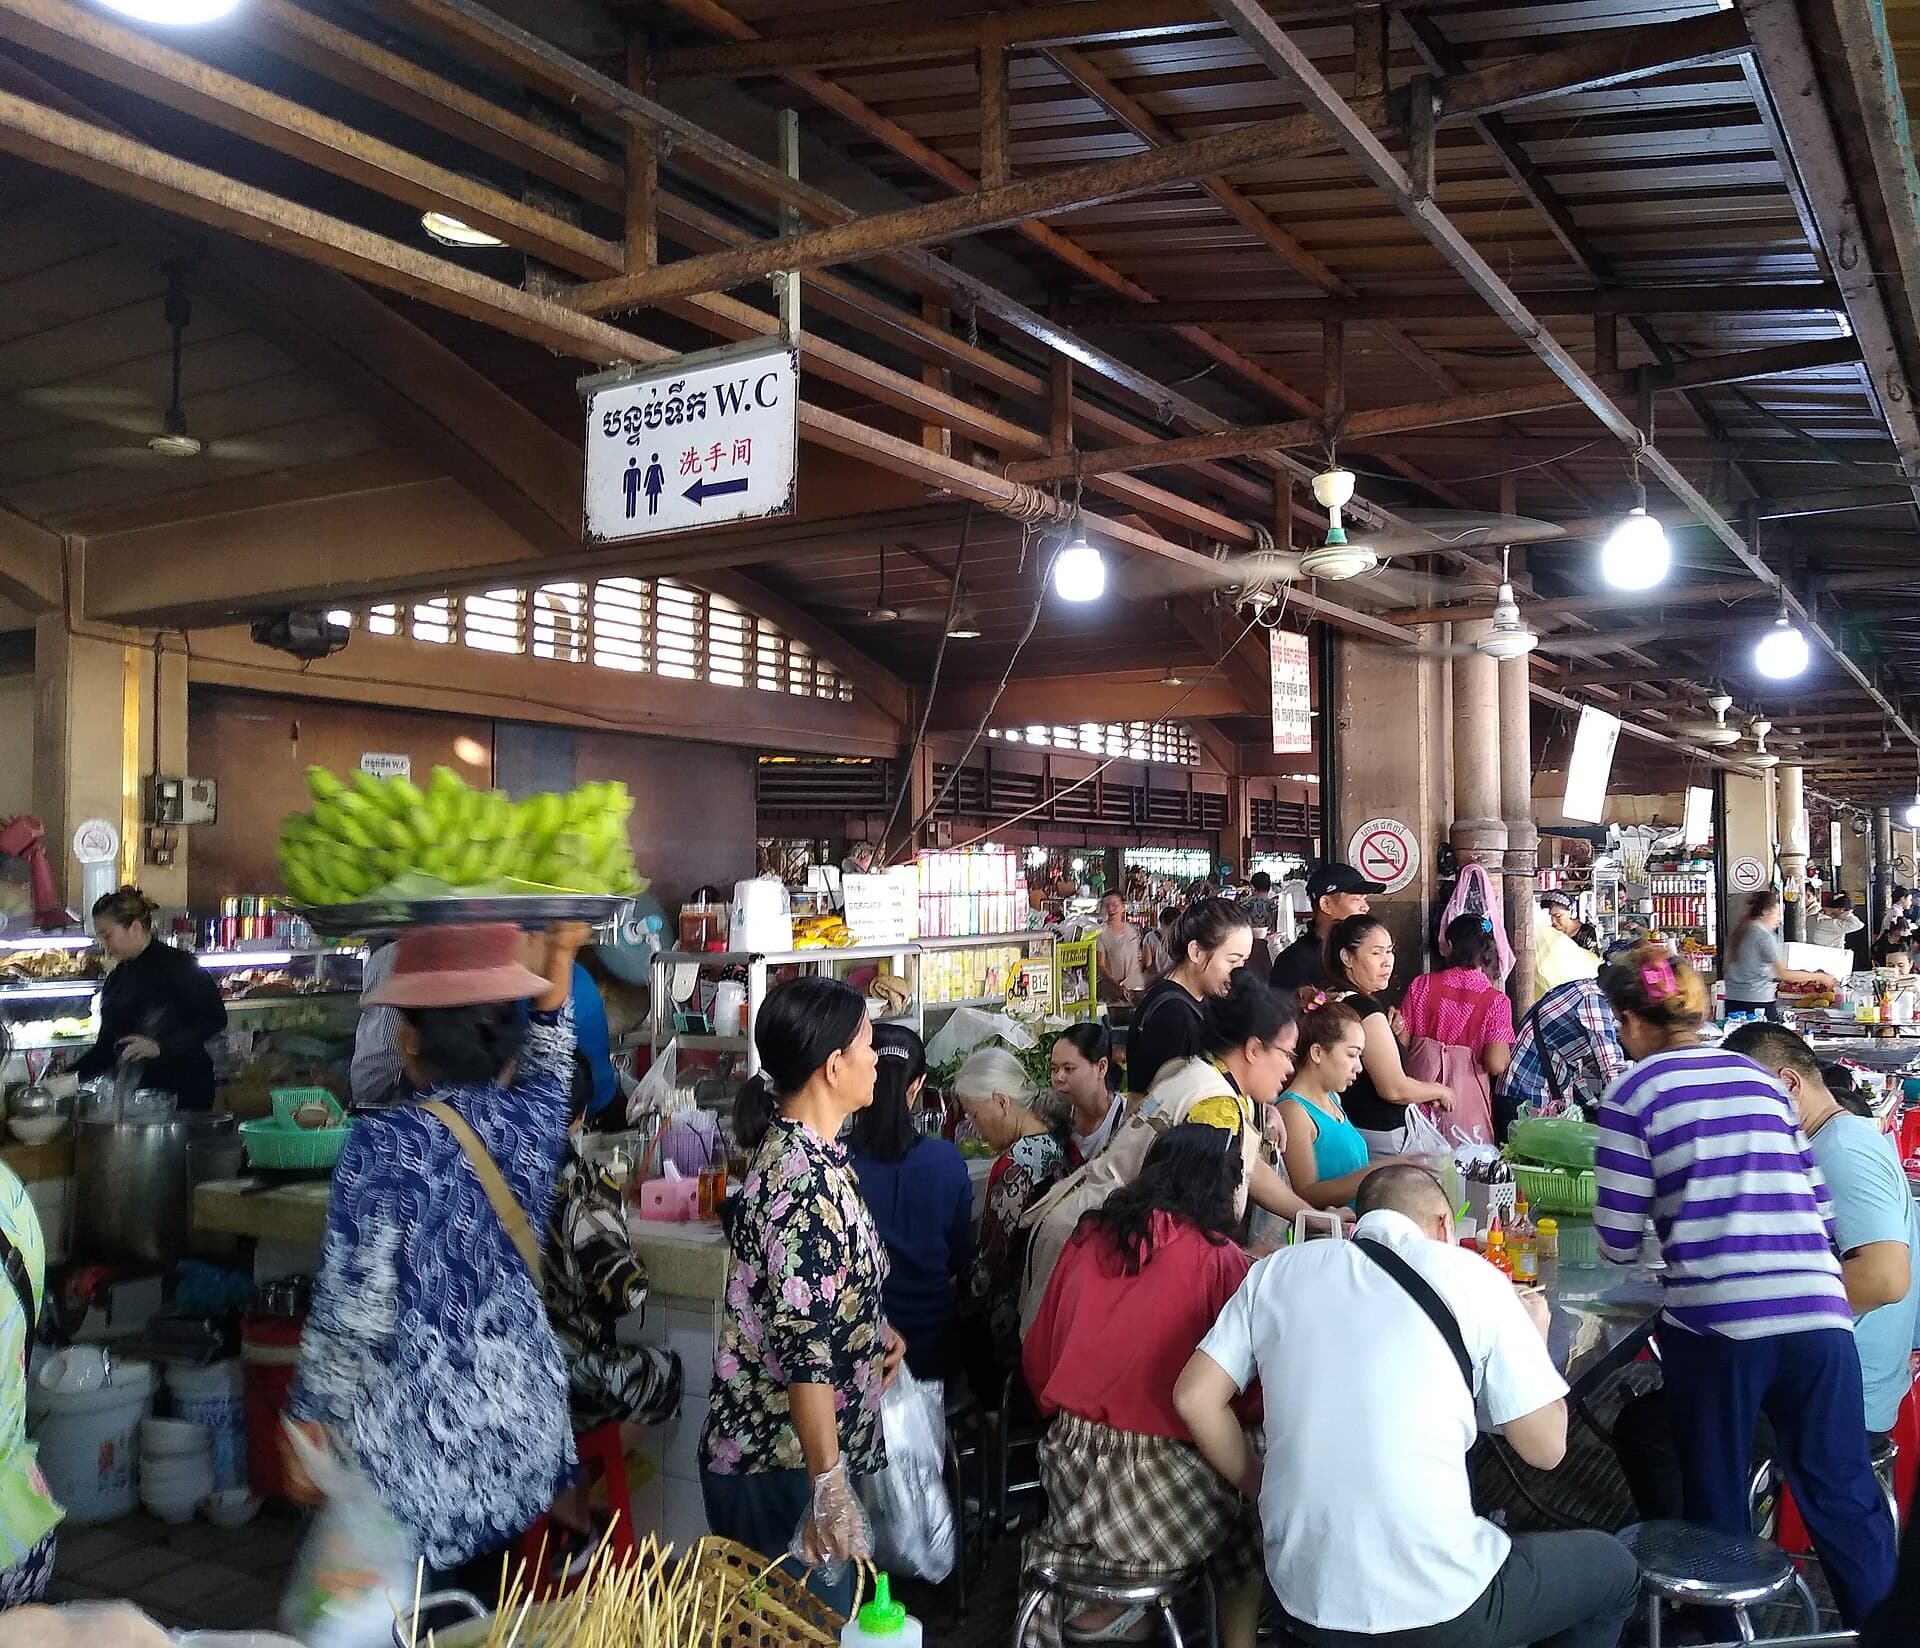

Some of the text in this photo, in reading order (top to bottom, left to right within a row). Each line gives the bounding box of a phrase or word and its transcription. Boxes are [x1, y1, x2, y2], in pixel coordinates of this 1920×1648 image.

[603, 373, 778, 447] បន្ទប់ទឹក W.C
[679, 438, 752, 476] 洗手间
[1032, 974, 1049, 990] B14
